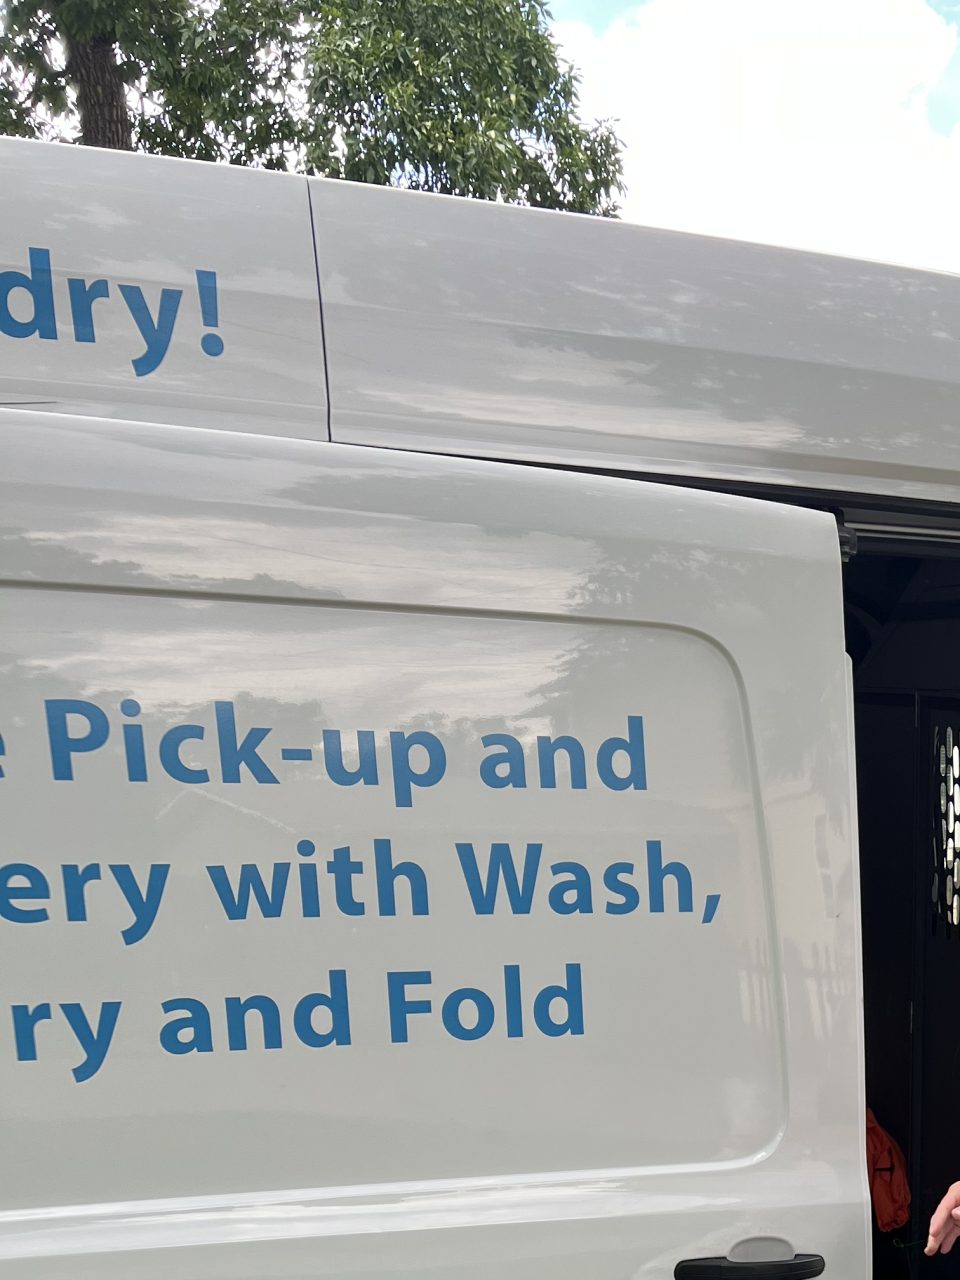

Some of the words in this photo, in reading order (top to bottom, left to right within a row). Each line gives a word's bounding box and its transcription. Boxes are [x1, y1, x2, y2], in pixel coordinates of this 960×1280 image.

[0, 247, 225, 378] dry!
[45, 698, 447, 808] Pick-up
[479, 715, 648, 791] and
[0, 862, 171, 946] ery
[206, 838, 430, 921] with
[455, 840, 722, 925] Wash,
[11, 1000, 123, 1084] ry
[160, 969, 352, 1056] and
[387, 963, 586, 1044] Fold
